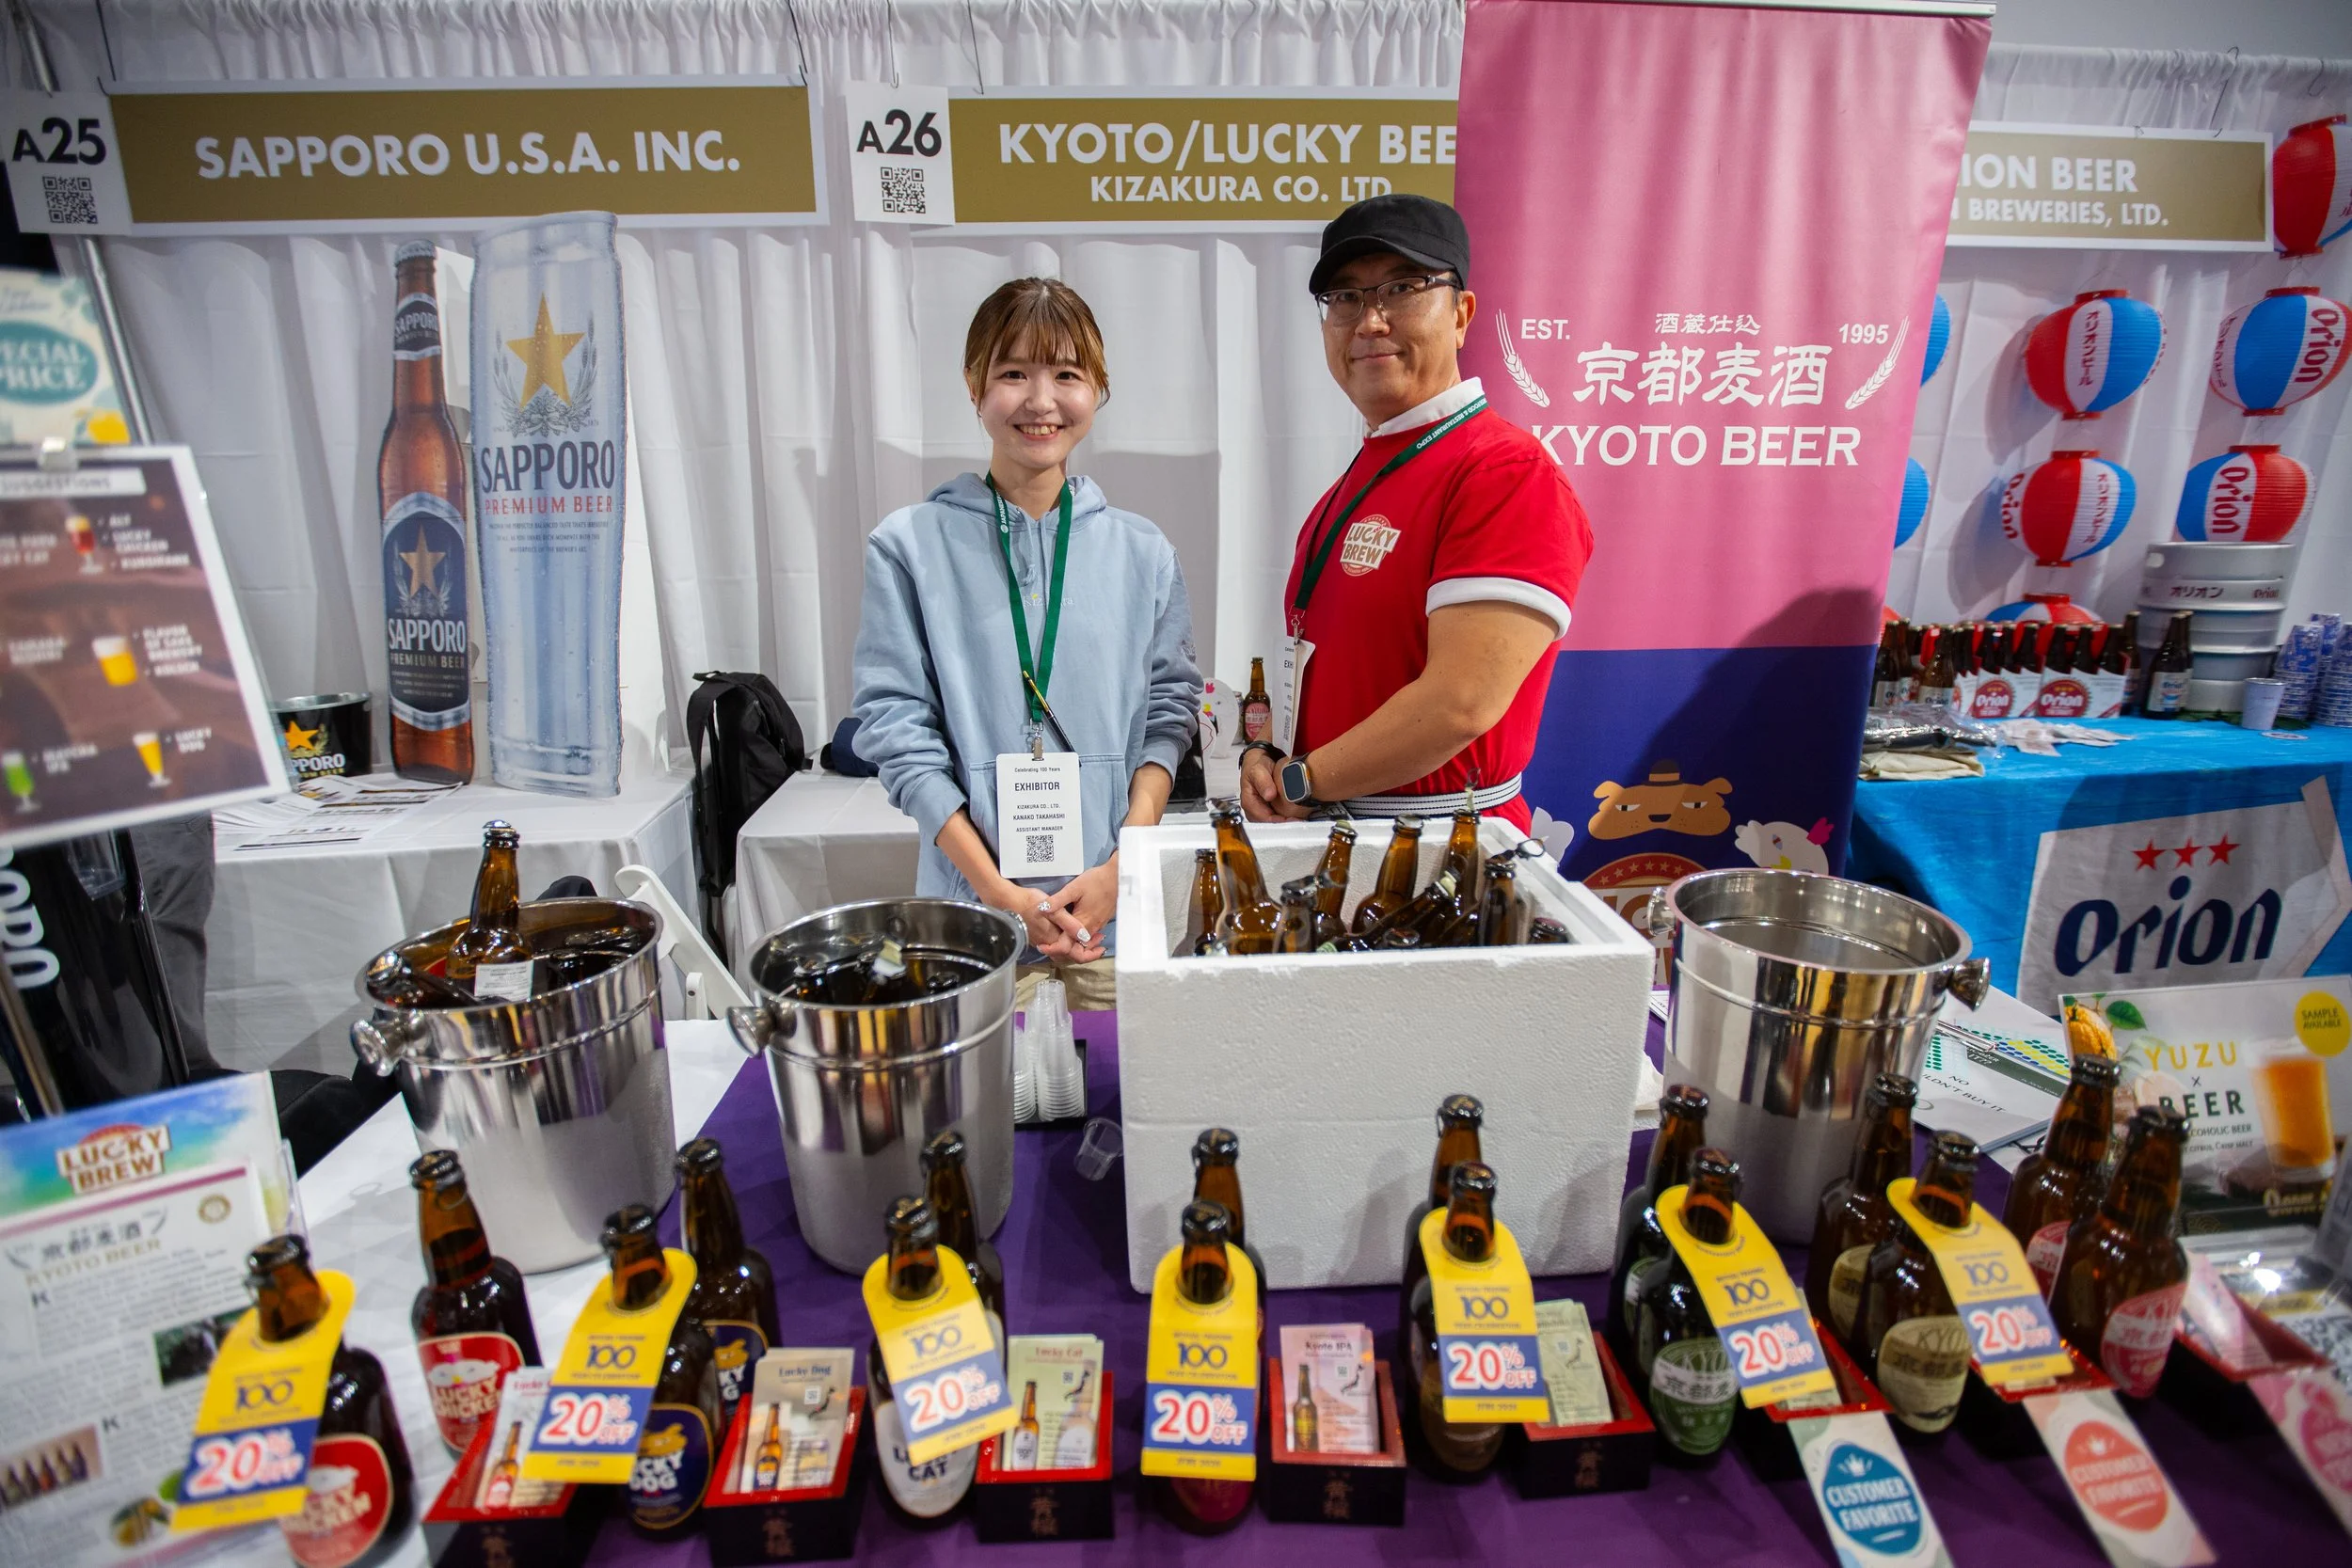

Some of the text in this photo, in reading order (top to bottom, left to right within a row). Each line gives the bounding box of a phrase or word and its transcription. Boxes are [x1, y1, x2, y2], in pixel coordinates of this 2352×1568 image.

[12, 118, 106, 165] A25
[856, 109, 942, 157] A26
[1000, 120, 1456, 170] KYOTO/LUCKY BEE
[195, 129, 739, 180] SAPPORO U.S.A. INC.
[1959, 153, 2138, 192] ION BEER
[1091, 176, 1263, 203] KIZAKURA
[1273, 176, 1328, 202] CO.
[1968, 198, 2112, 227] BREWERIES,
[2122, 203, 2169, 226] LTD.
[1520, 319, 1570, 340] EST.
[1655, 312, 1762, 336] 酒蔵仕込
[1838, 324, 1889, 344] 1995
[2294, 309, 2342, 383] Orion
[1572, 341, 1833, 407] 京都麦酒
[1531, 424, 1862, 467] KYOTO BEER
[481, 439, 615, 494] SAPPORO
[485, 496, 612, 515] PREMIUM BEER
[2211, 466, 2253, 534] Orion
[1346, 525, 1398, 547] LUCKY
[1342, 543, 1383, 564] BREW
[2170, 586, 2225, 598] オリオン
[388, 617, 467, 654] SAPPORO
[1977, 691, 2010, 707] Orion
[2041, 691, 2084, 707] Orion
[291, 753, 346, 772] PPORO
[1014, 782, 1060, 791] EXHIBITOR
[2301, 1007, 2339, 1020] SAMPLE
[2302, 1020, 2342, 1030] AVAILABLE
[2143, 1040, 2238, 1072] YUZU
[1923, 1073, 1963, 1094] LDN'T
[1963, 1092, 1991, 1105] BUY
[1949, 1075, 1970, 1085] NO
[2188, 1123, 2252, 1137] COHOLIC BEER
[62, 1129, 161, 1171] LUCKY
[76, 1154, 154, 1191] BREW
[1724, 1277, 1770, 1306] 100
[1460, 1296, 1509, 1320] 100
[910, 1324, 962, 1357] 100
[1178, 1342, 1228, 1369] 100
[778, 1366, 832, 1377] Lucky Dog
[1504, 1368, 1537, 1388] OFF
[1211, 1420, 1248, 1446] OFF
[636, 1449, 684, 1475] UCKY
[907, 1463, 949, 1481] CAT
[1826, 1475, 1909, 1508] CUSTOMER
[1838, 1498, 1918, 1531] FAVORITE
